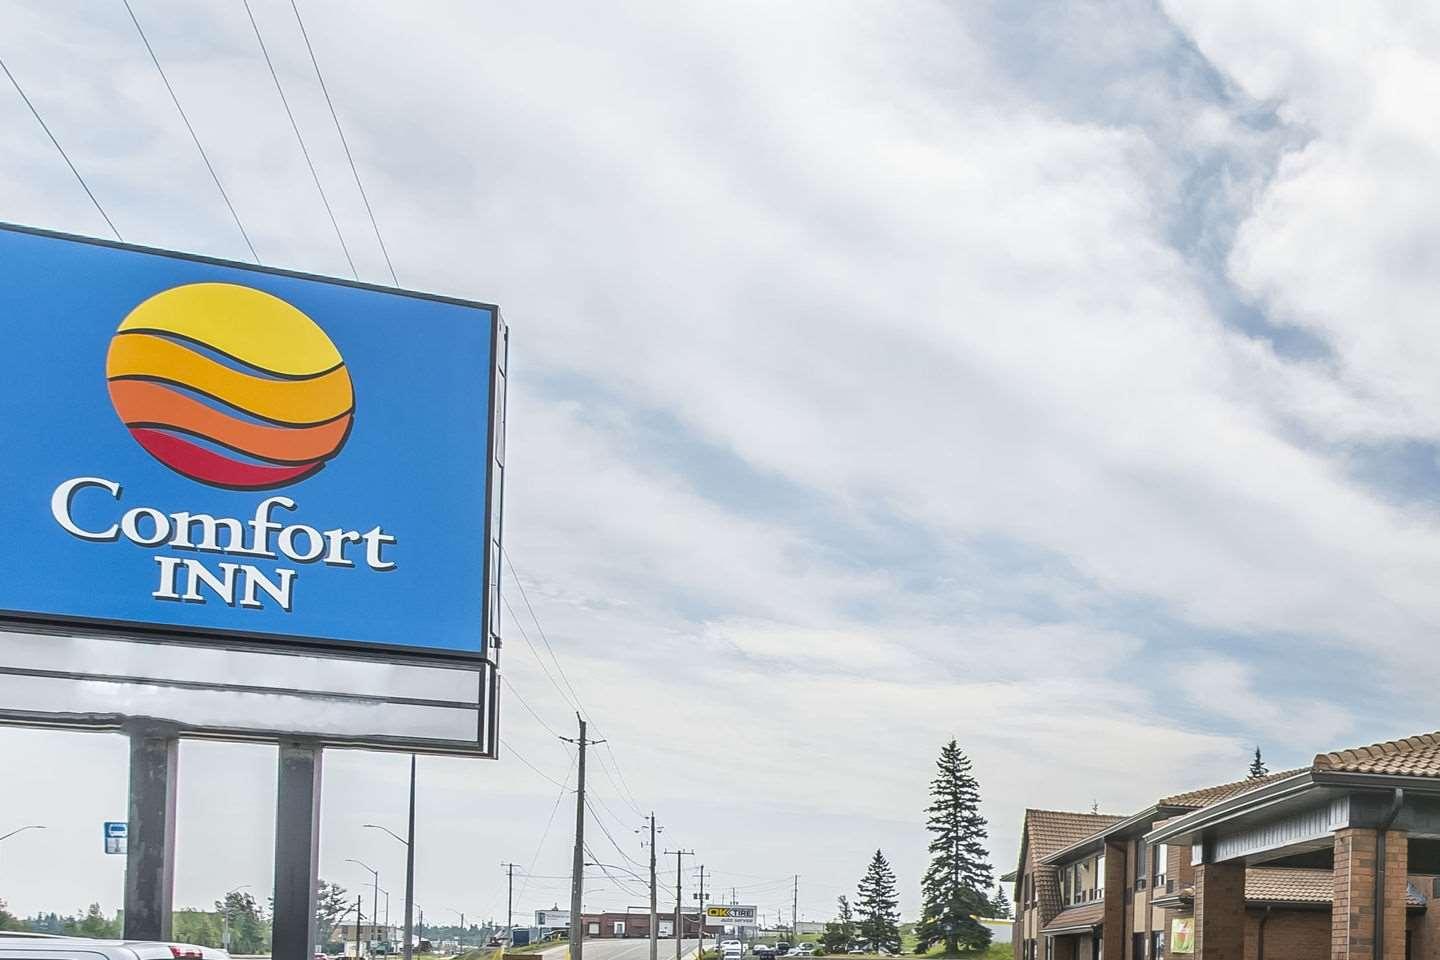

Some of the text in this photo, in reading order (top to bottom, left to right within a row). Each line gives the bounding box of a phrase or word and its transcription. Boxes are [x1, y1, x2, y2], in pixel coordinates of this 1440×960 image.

[51, 476, 397, 571] Comfort
[152, 555, 297, 612] INN
[709, 908, 728, 917] OK
